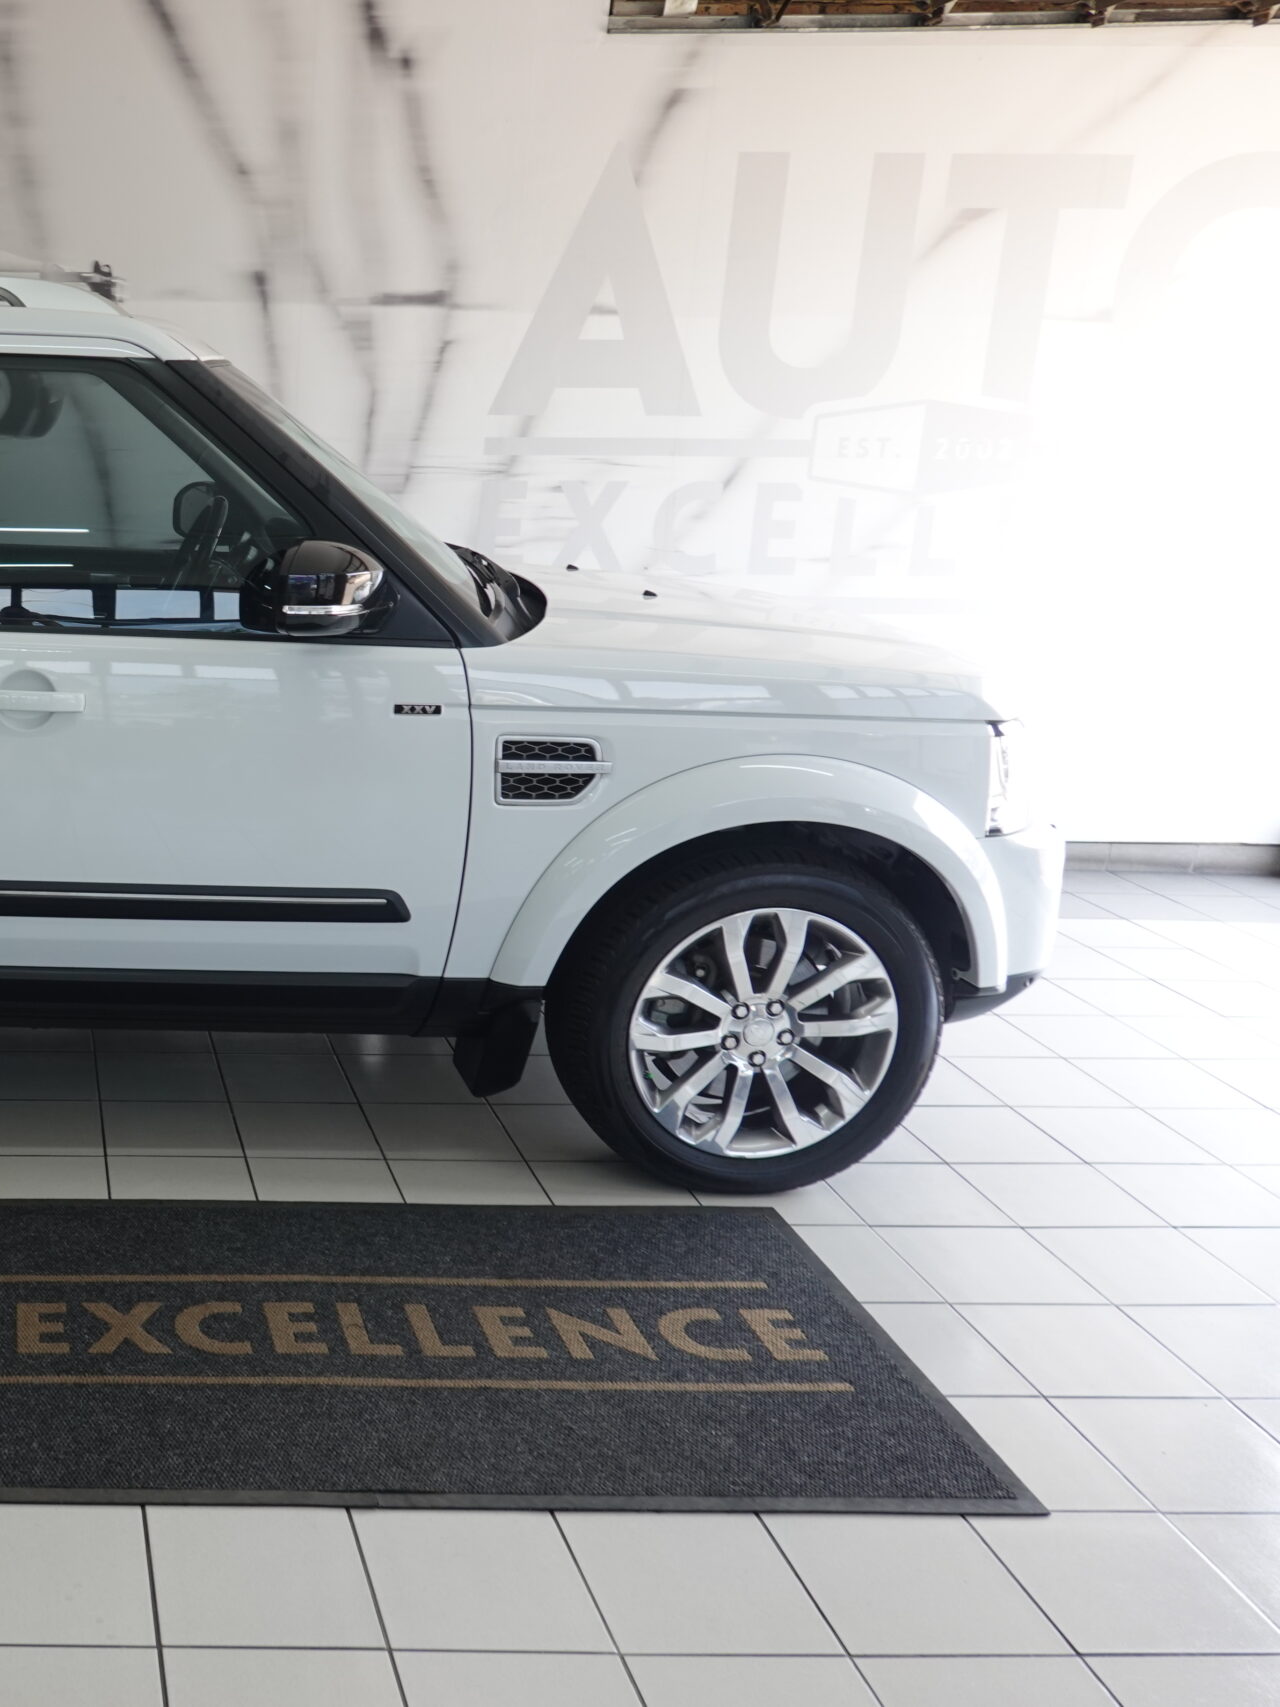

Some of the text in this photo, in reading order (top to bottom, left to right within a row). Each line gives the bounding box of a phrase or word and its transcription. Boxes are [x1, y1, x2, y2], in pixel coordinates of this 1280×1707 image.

[933, 437, 1015, 462] 2002
[401, 705, 436, 714] XXV
[15, 1300, 830, 1363] EXCELLENCE
